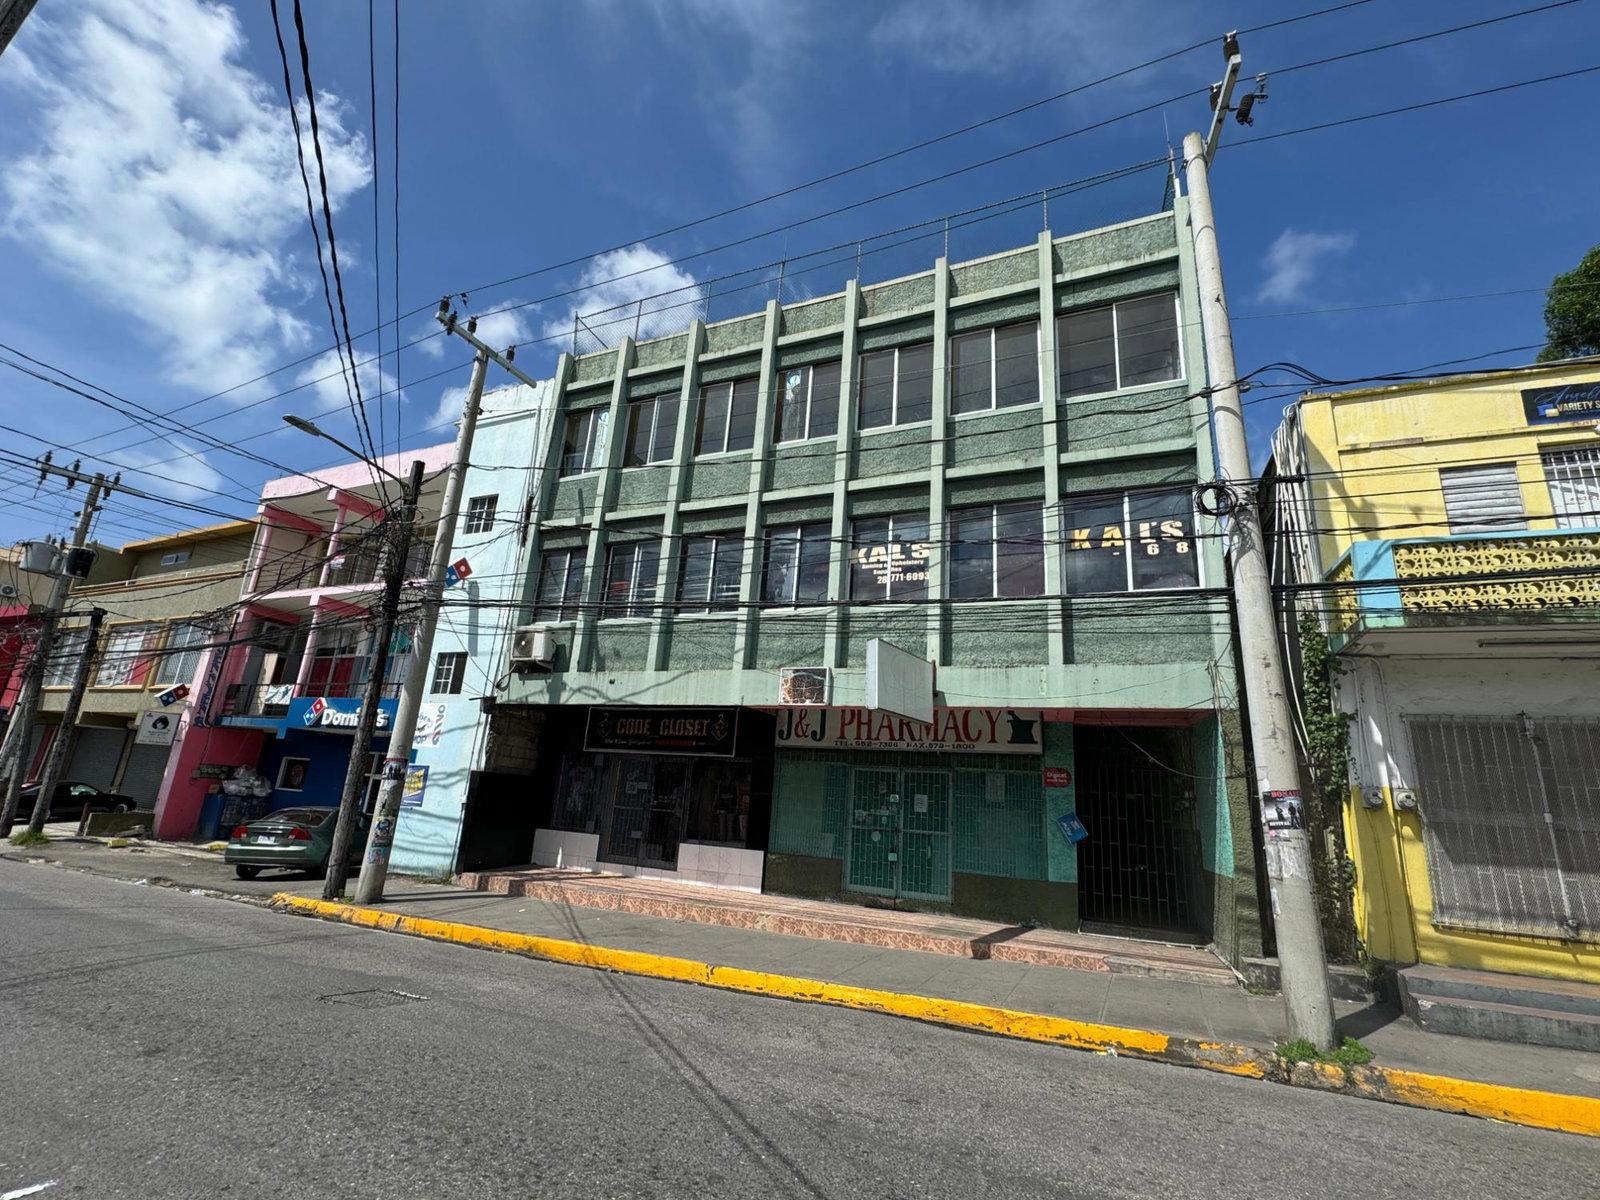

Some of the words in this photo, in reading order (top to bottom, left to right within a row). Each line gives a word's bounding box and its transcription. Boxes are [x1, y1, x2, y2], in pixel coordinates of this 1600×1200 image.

[1557, 401, 1593, 412] VARIETY
[850, 543, 930, 564] KAL'S
[321, 706, 388, 728] Domi's
[777, 708, 827, 742] J&J
